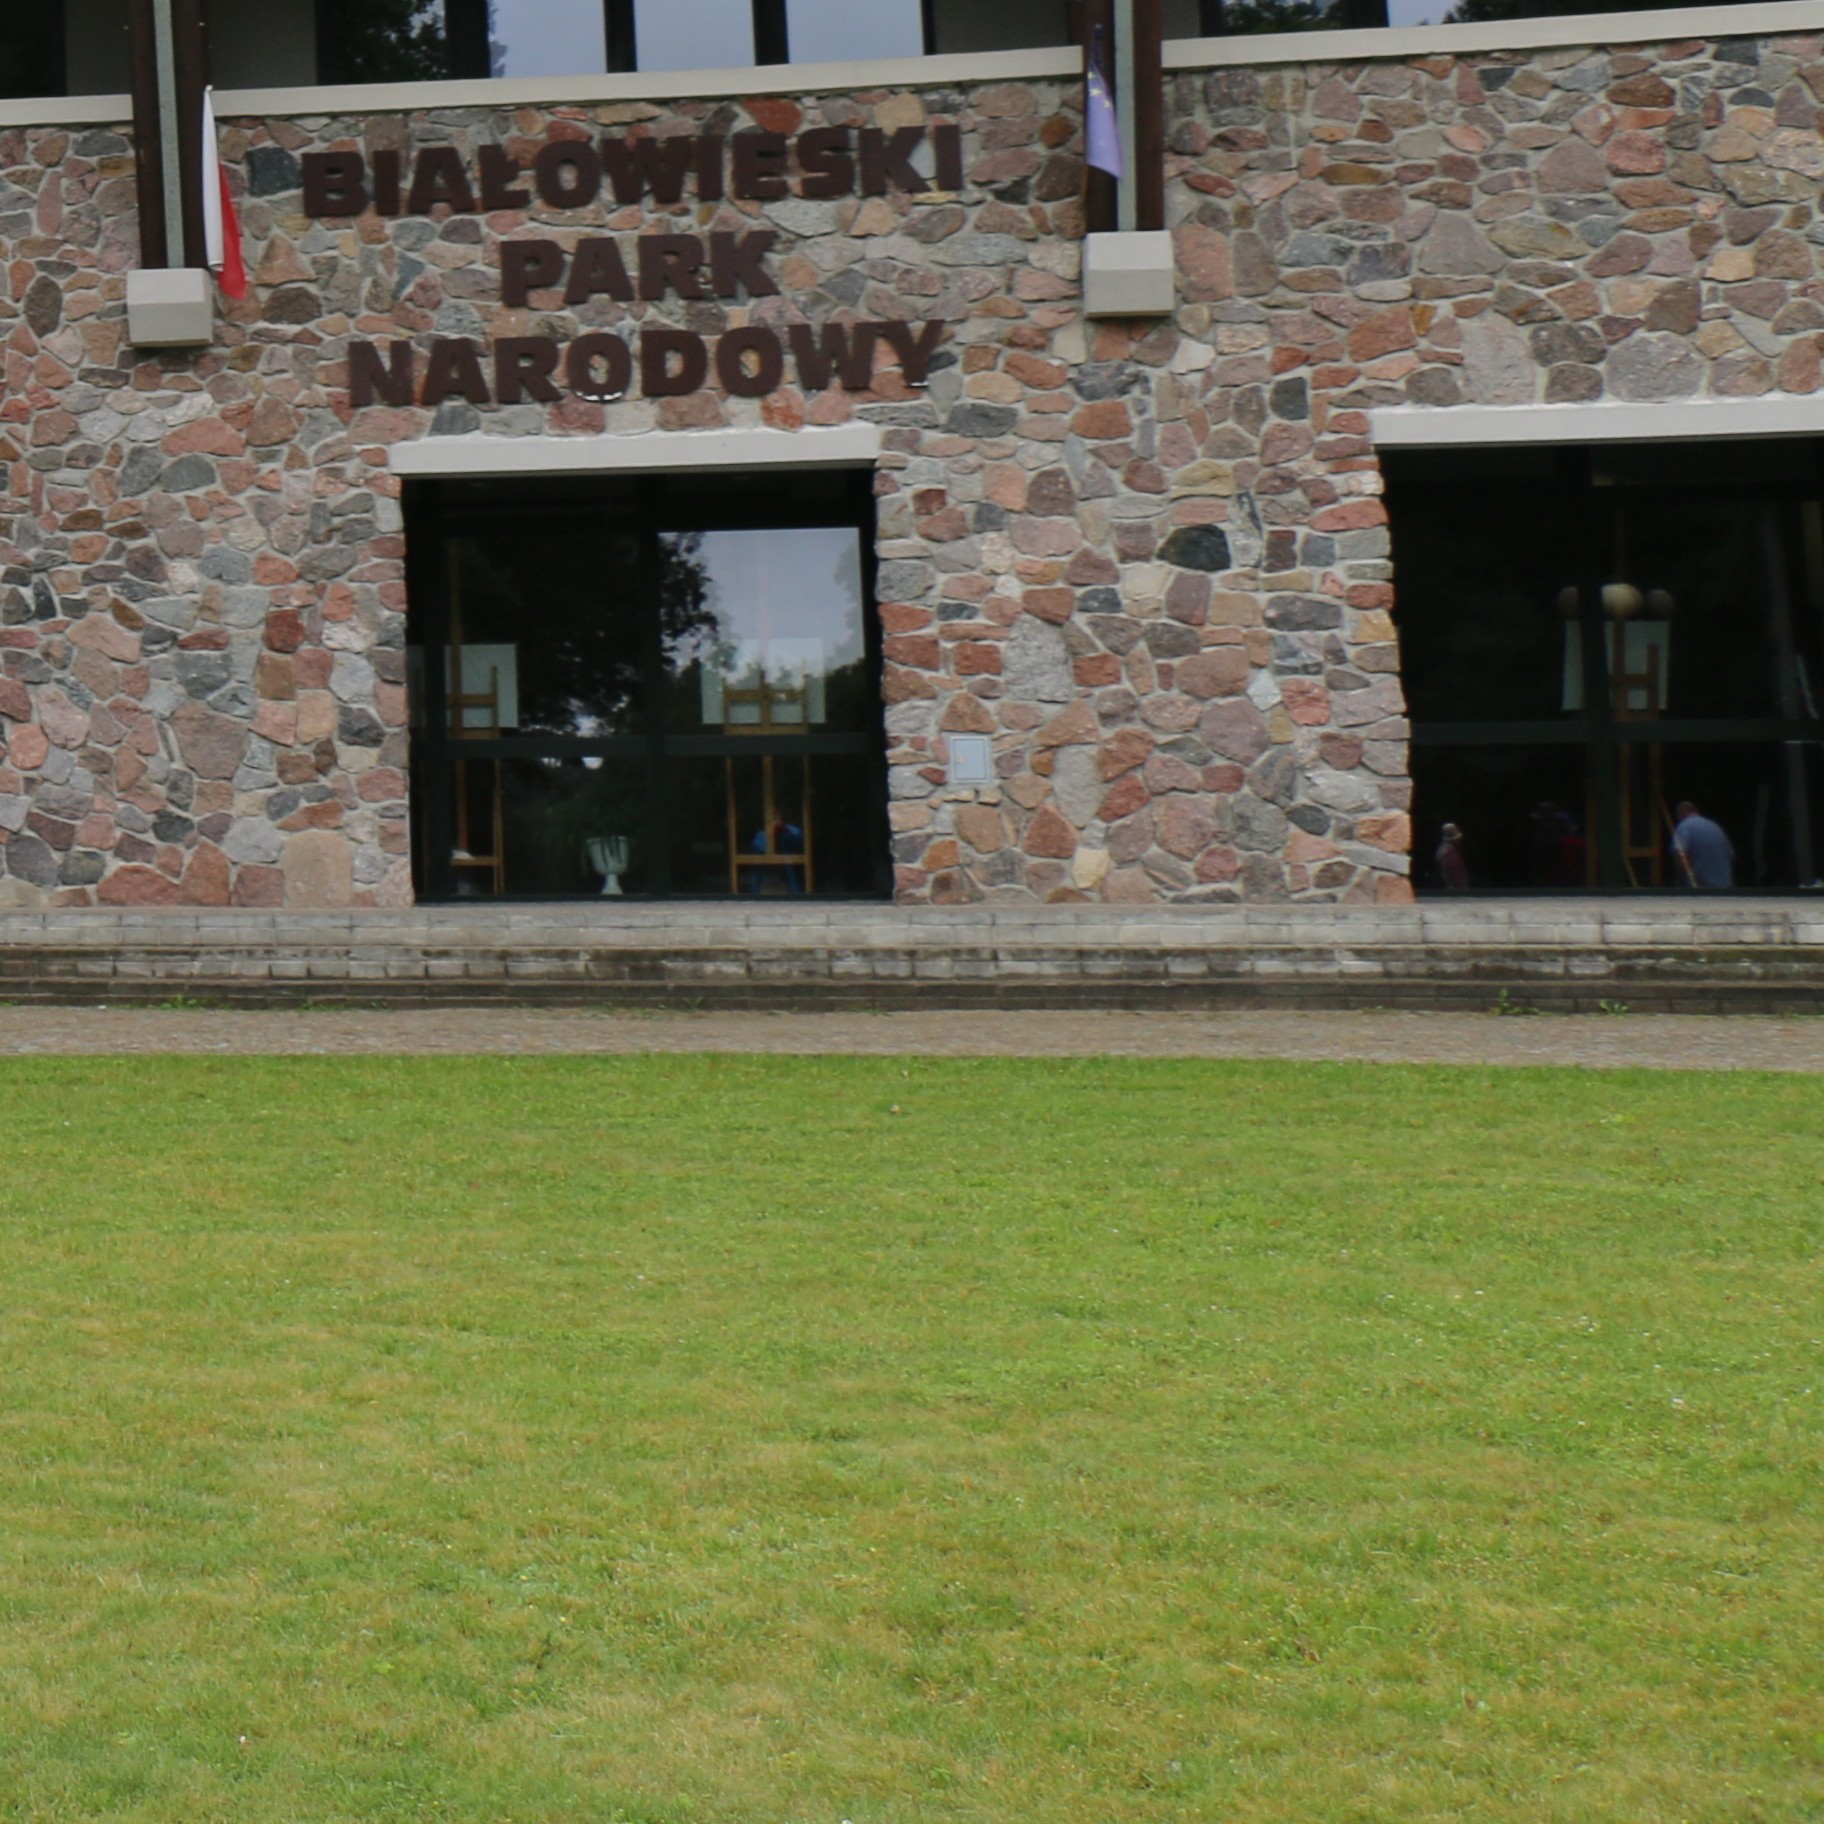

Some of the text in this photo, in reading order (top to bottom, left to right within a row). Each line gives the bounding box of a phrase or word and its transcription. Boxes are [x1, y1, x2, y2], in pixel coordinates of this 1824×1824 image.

[302, 125, 963, 217] BIAŁOWIESKI
[500, 230, 779, 307] PARK
[350, 320, 944, 407] NARODOWY
